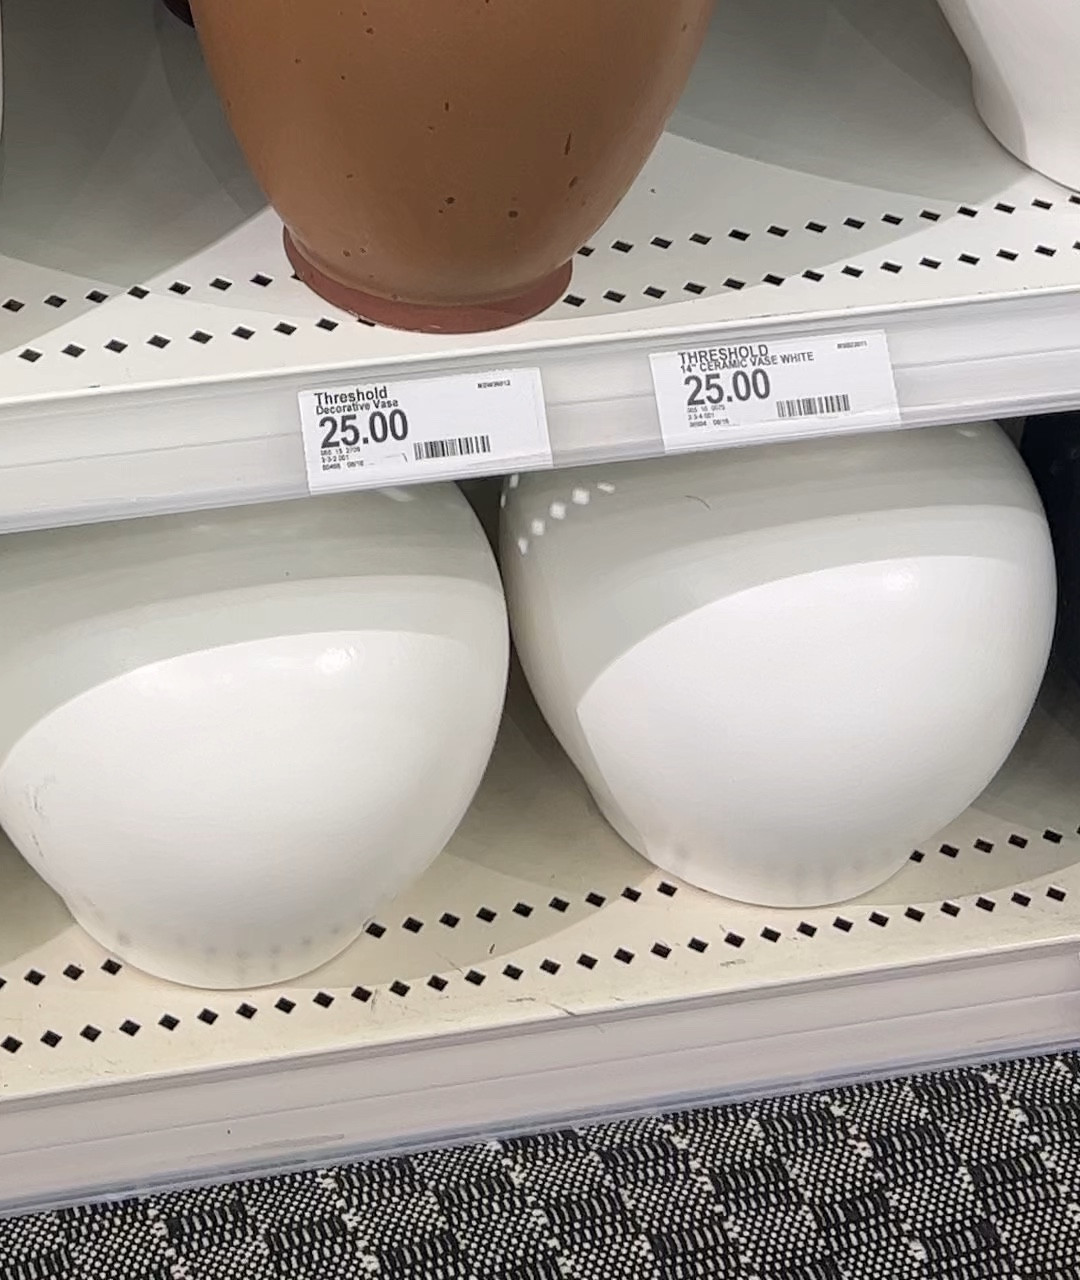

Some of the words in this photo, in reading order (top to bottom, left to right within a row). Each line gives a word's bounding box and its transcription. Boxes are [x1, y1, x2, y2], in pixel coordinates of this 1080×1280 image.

[678, 344, 768, 365] THRESHOLD
[699, 359, 747, 373] CERAMIC
[749, 355, 778, 368] VASE
[780, 351, 814, 364] WHITE
[314, 386, 388, 406] Threshold
[684, 368, 771, 406] 25.00
[316, 402, 370, 416] Decorative
[373, 399, 399, 410] Vase
[319, 409, 409, 449] 25.00
